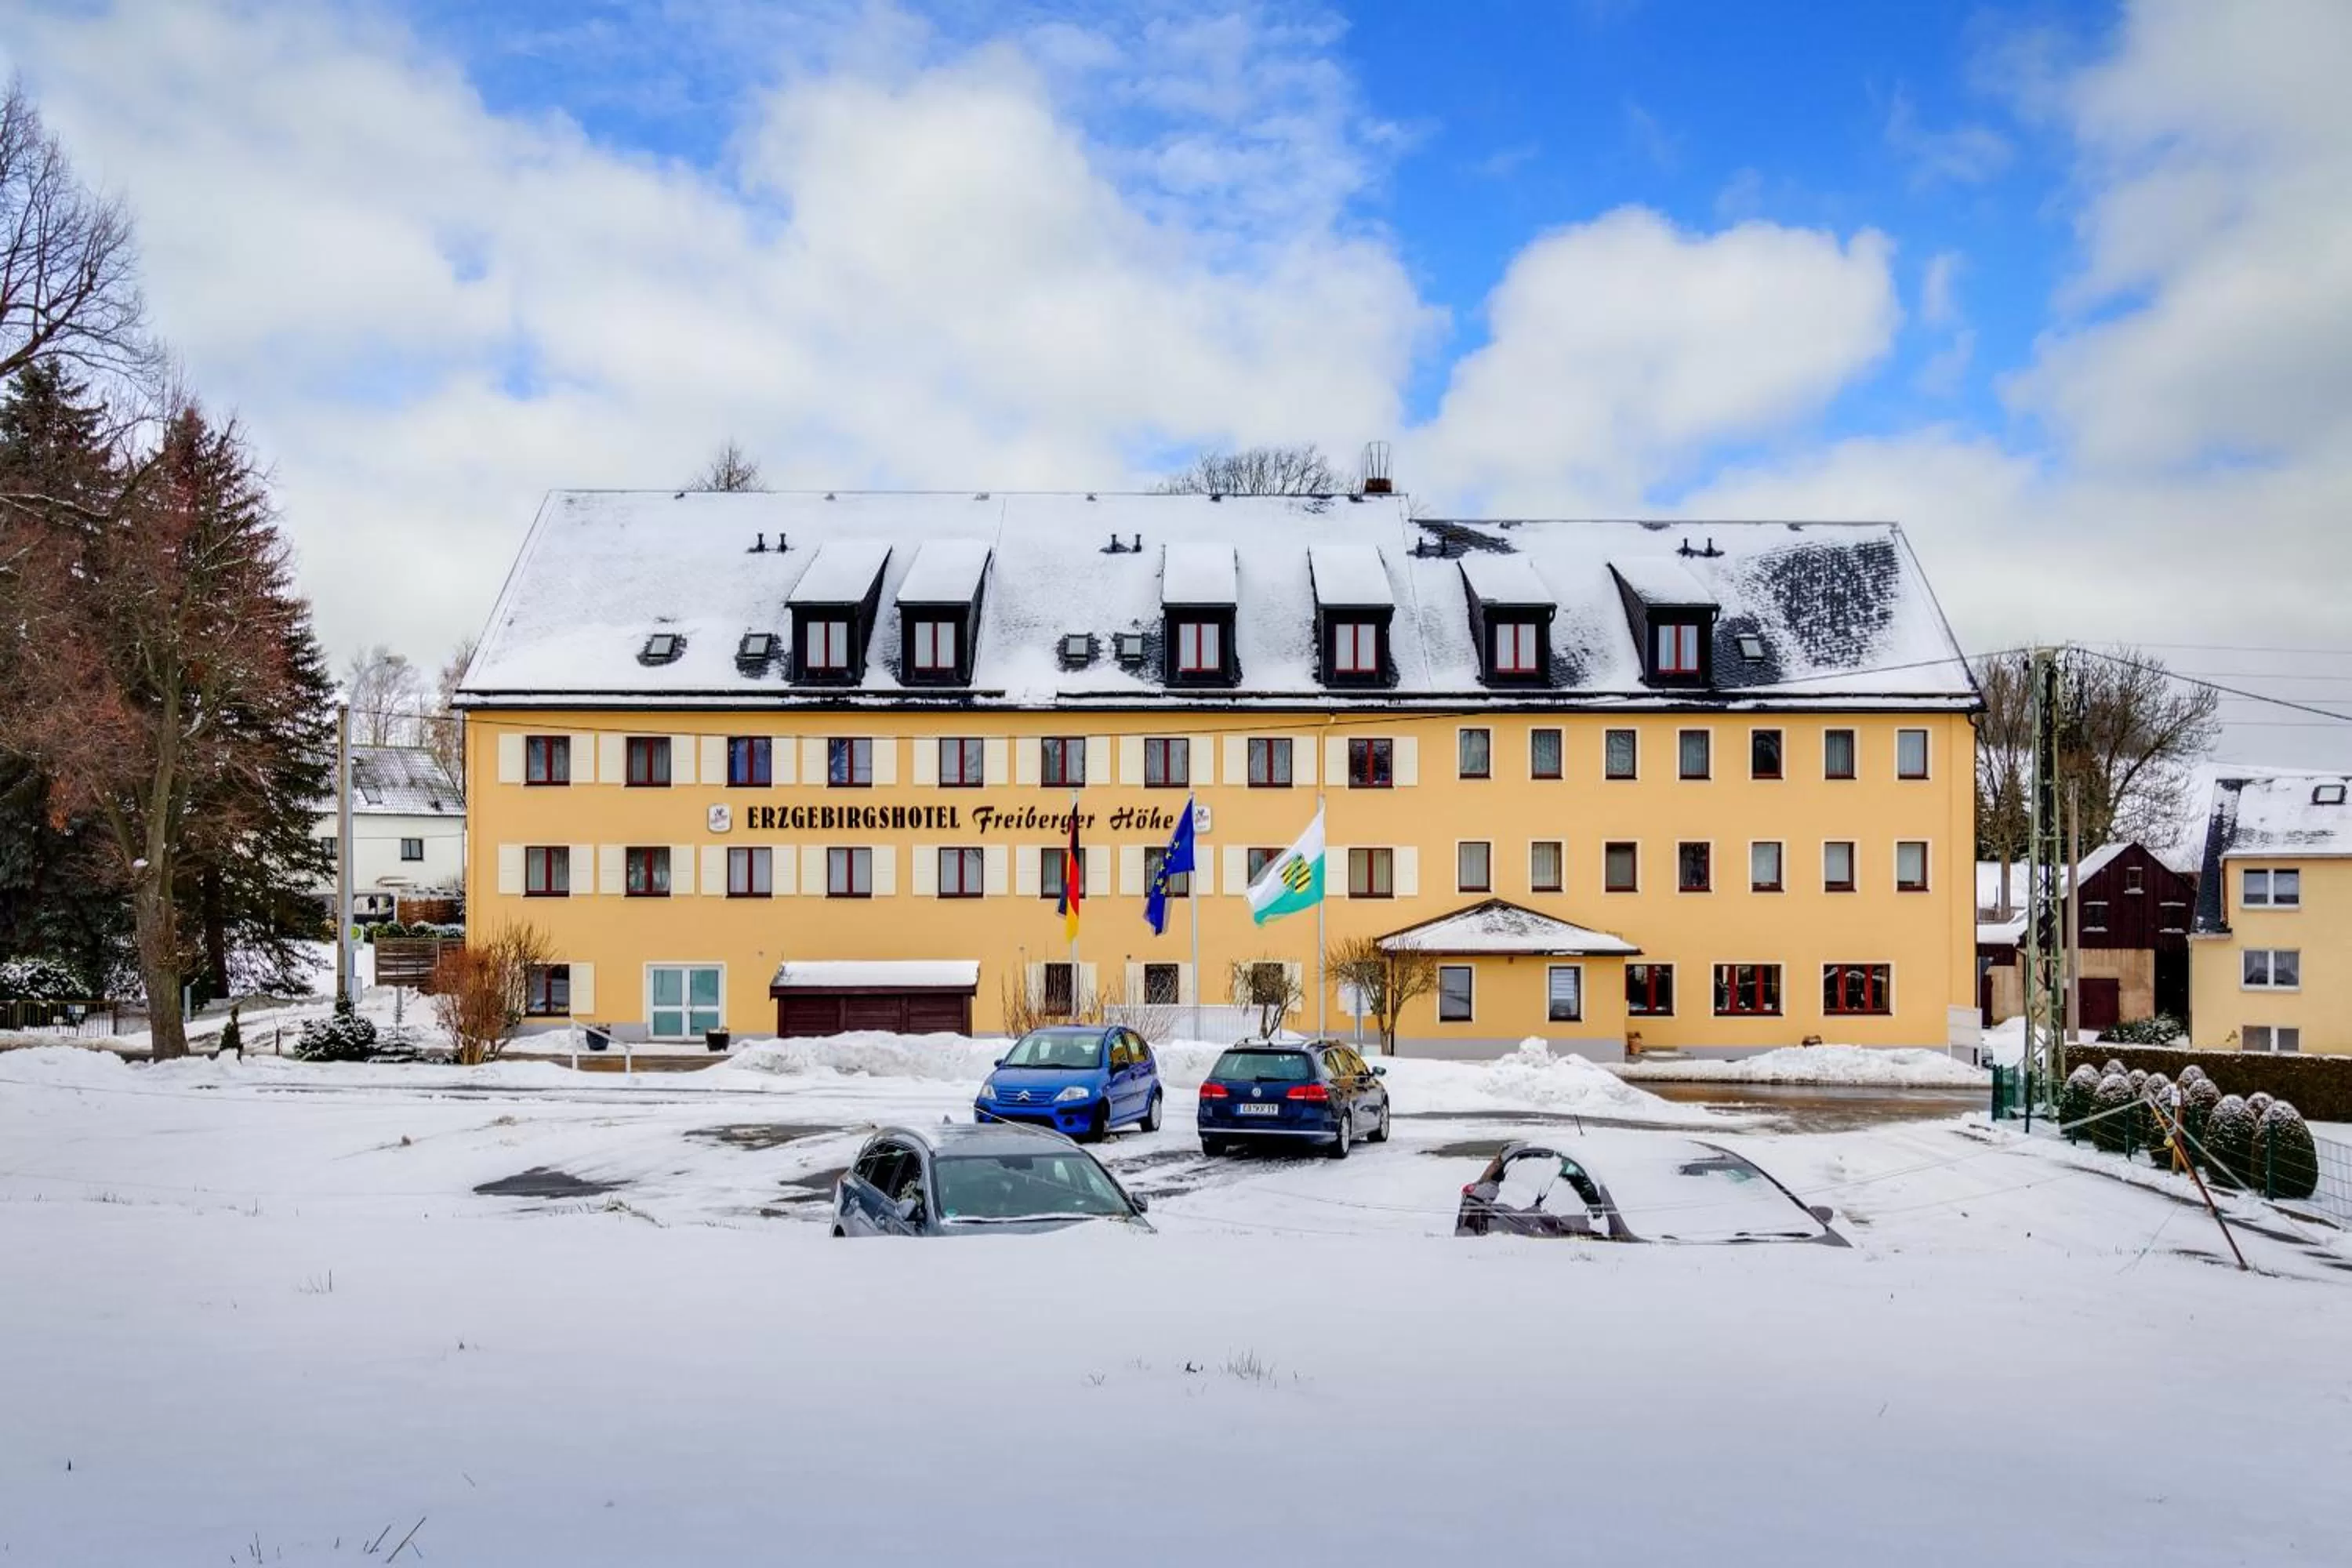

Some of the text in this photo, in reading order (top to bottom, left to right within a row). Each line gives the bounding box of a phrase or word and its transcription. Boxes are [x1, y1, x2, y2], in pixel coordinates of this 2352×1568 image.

[747, 806, 960, 829] ERZGEBIRGSHOTEL
[971, 805, 1095, 834] Freiberger
[1109, 807, 1174, 830] Höhe
